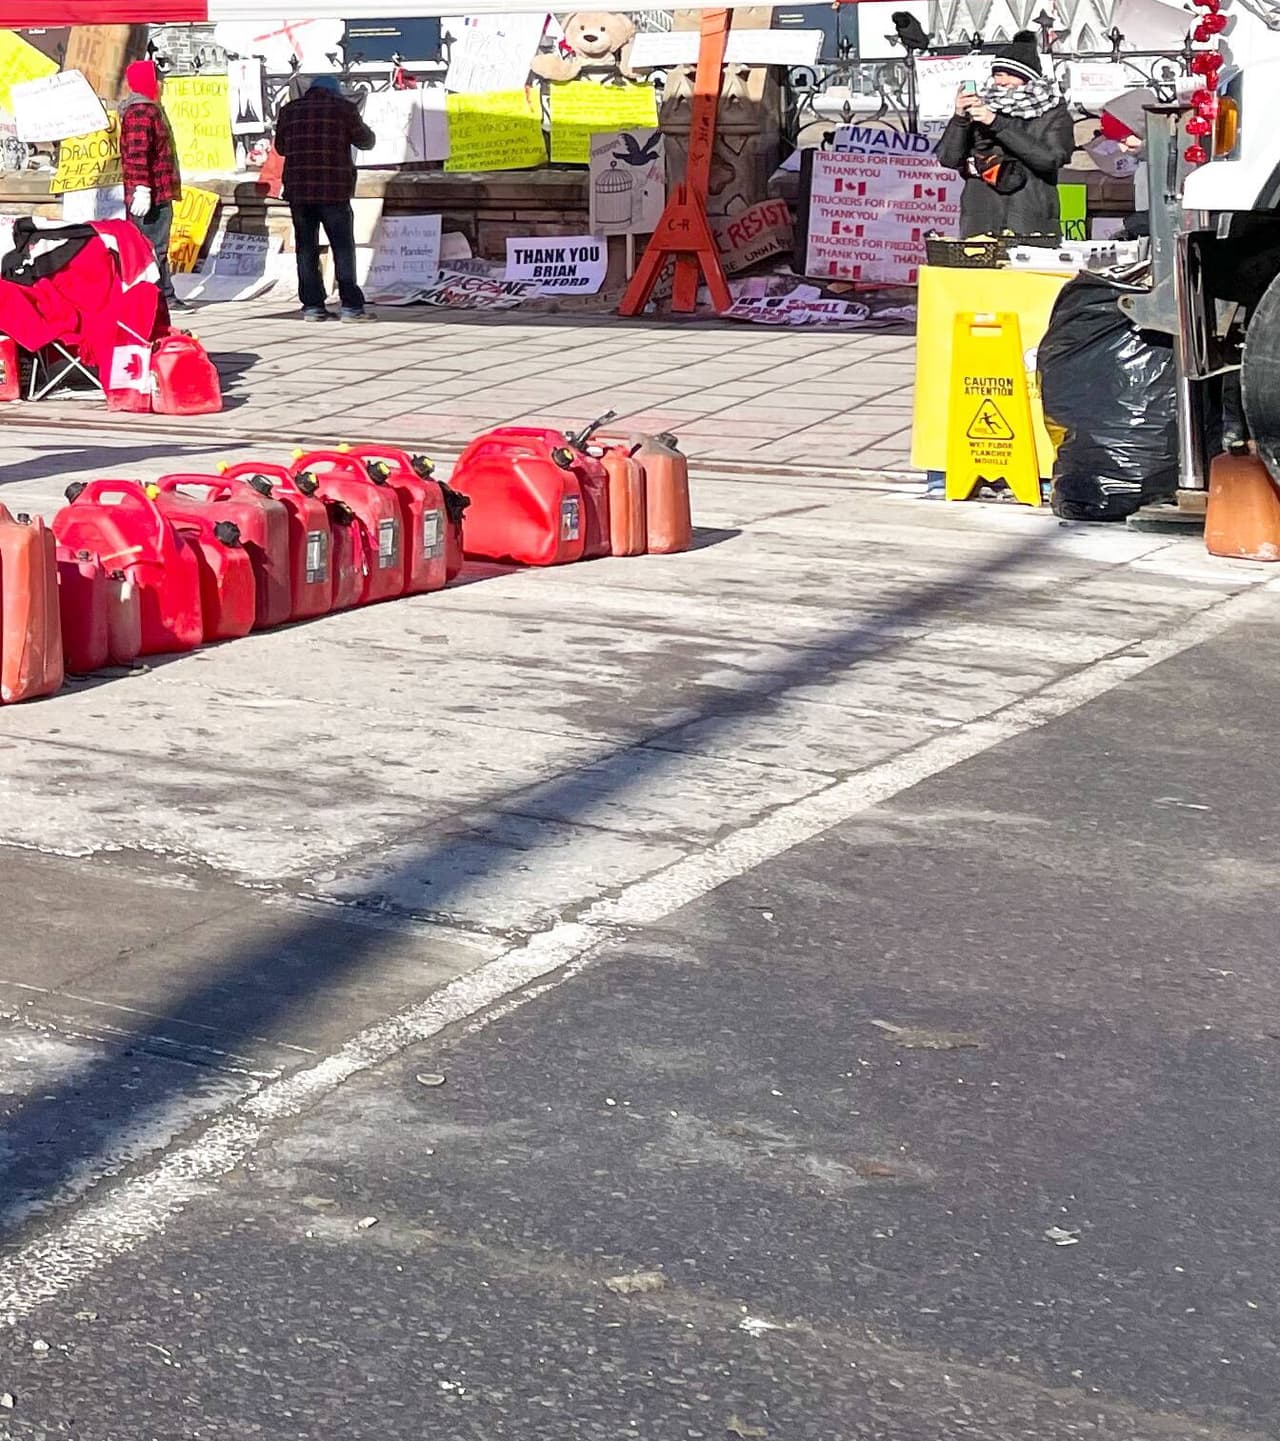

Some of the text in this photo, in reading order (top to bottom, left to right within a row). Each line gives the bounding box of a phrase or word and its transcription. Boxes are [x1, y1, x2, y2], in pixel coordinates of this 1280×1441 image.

[815, 152, 939, 168] TRUCKERS FOR FREEDOM
[823, 165, 957, 182] THANK YOU THANK YOU
[812, 194, 862, 206] TRUCKERS
[864, 199, 886, 208] FOR
[887, 200, 937, 212] FREEDOM
[820, 208, 955, 225] THANK YOU THANK YOU
[667, 218, 690, 231] C-R
[727, 202, 789, 249] RESIST
[810, 234, 860, 247] TRUCKERS
[862, 239, 883, 248] FOR
[513, 246, 600, 264] THANK YOU
[816, 247, 852, 259] THANK
[533, 264, 577, 278] BRIAN
[436, 271, 536, 297] VACCINE
[964, 376, 1013, 387] CAUTION
[964, 386, 1013, 396] ATTENTION
[970, 449, 1012, 457] PLANCHER
